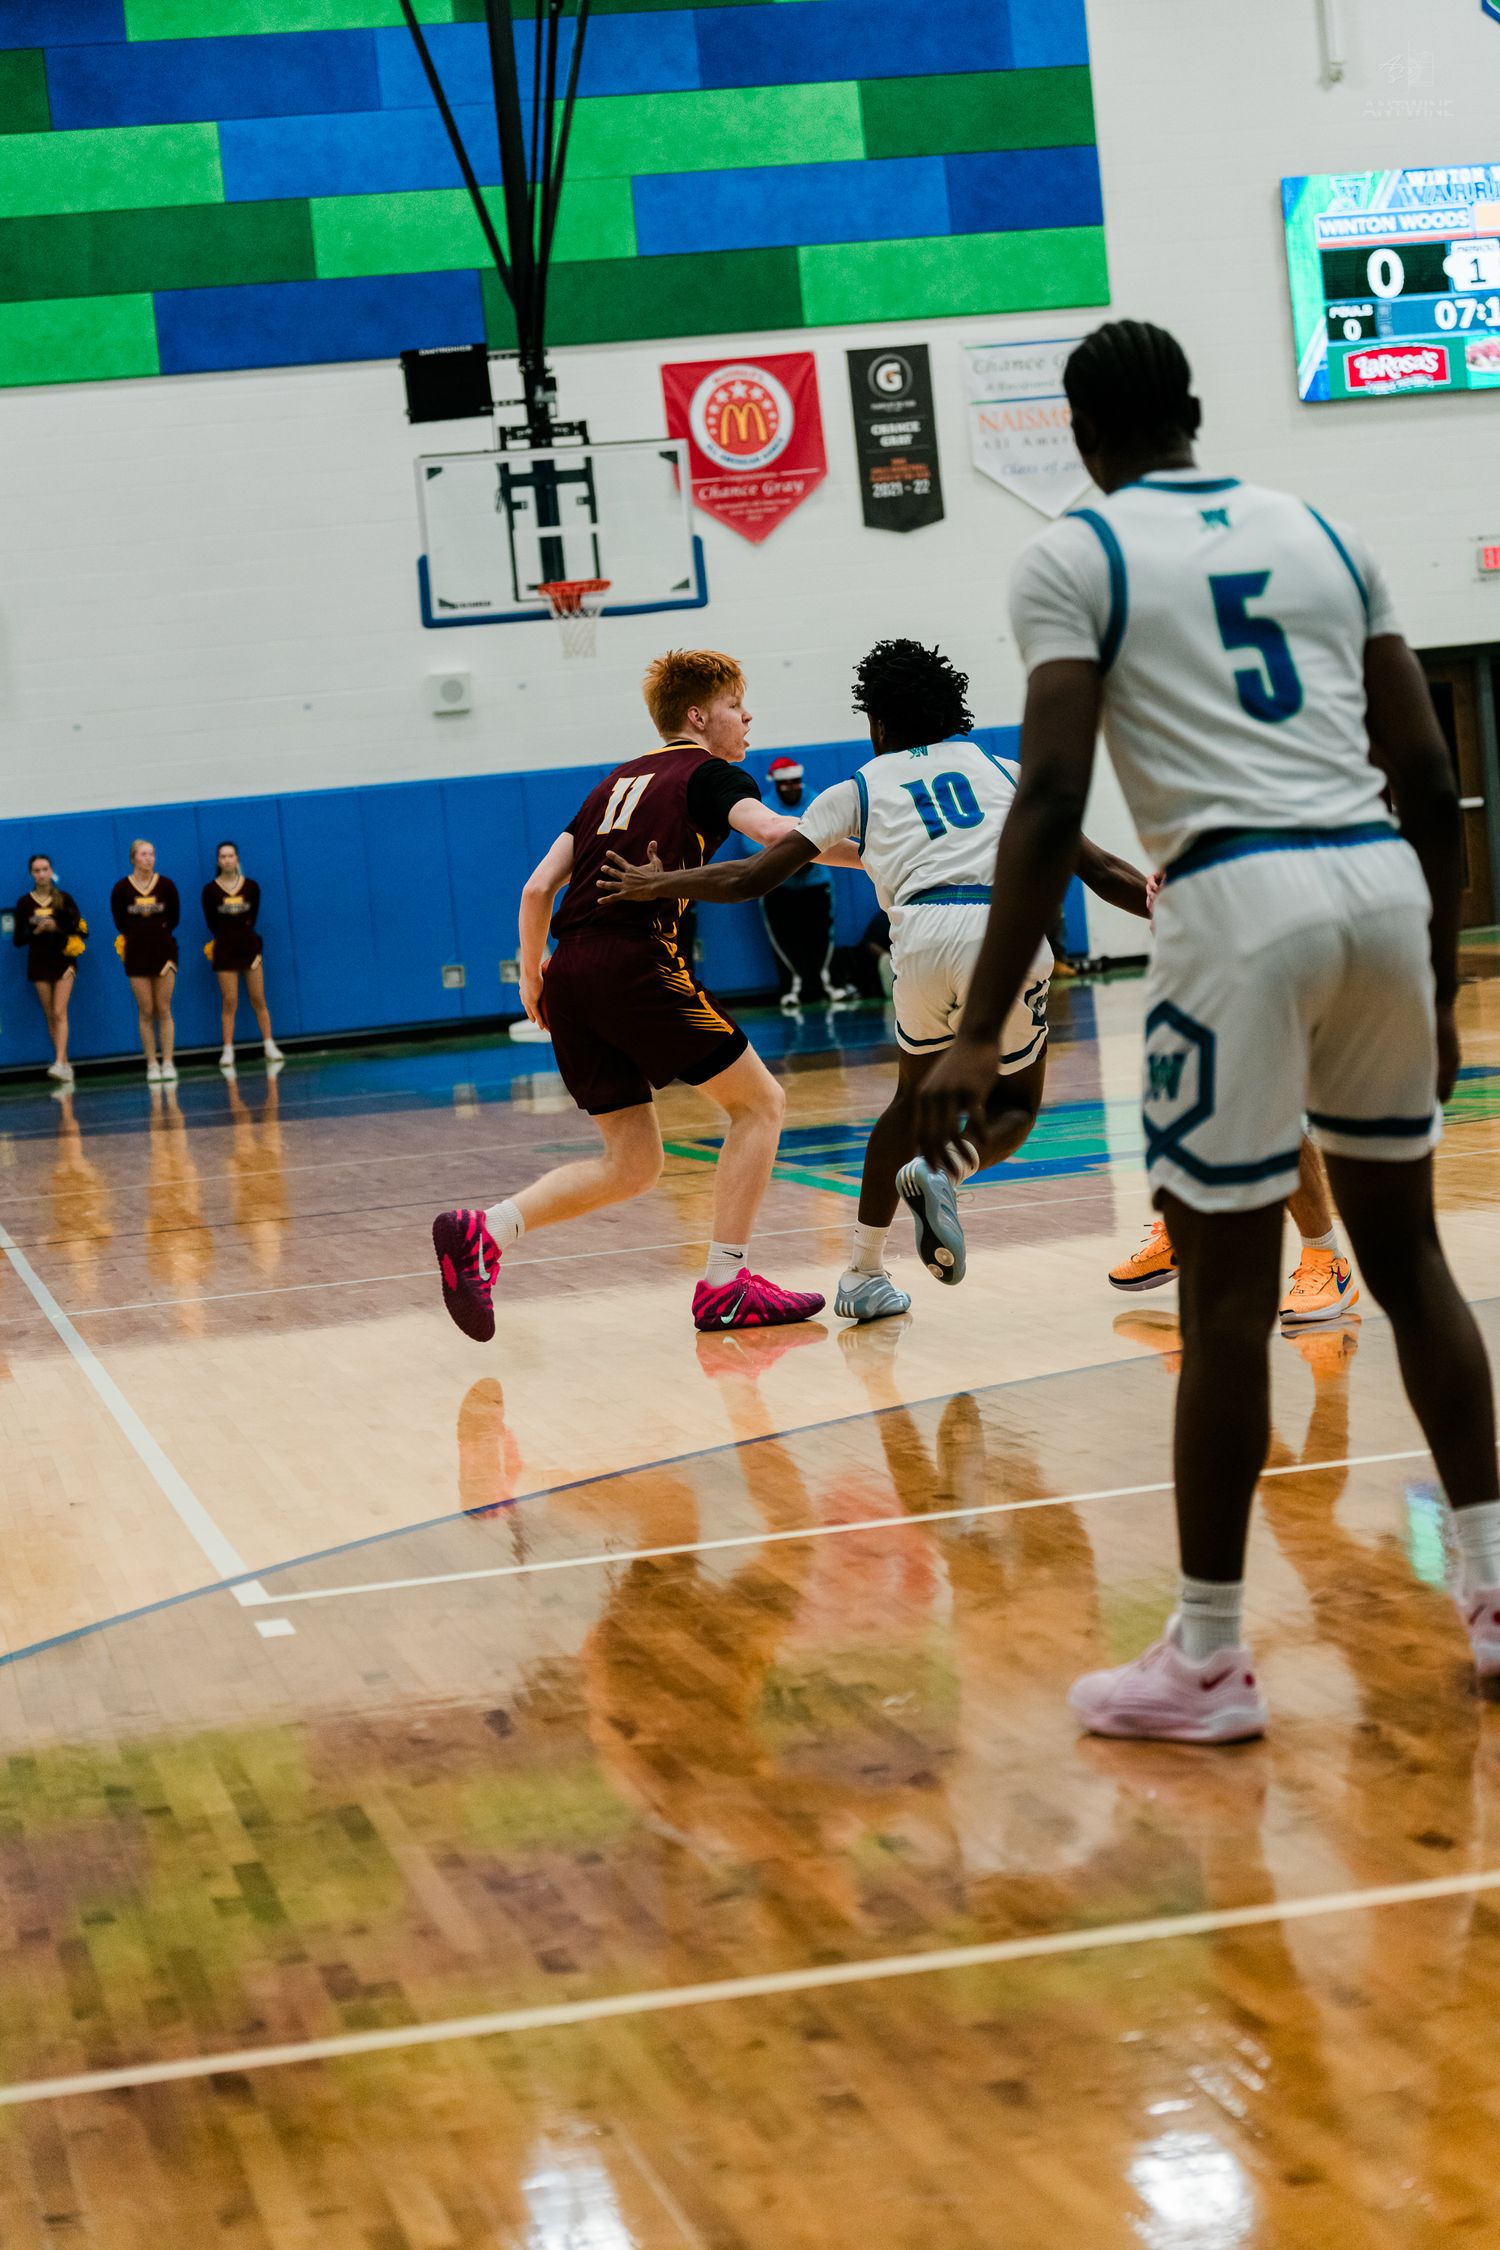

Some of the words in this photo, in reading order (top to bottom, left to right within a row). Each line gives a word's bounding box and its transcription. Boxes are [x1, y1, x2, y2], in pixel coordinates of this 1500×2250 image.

[1319, 215, 1397, 236] WINTON
[1399, 209, 1469, 231] WOODS
[1367, 248, 1404, 298] 0
[1470, 258, 1486, 283] 1
[1343, 318, 1362, 341] 0
[698, 484, 759, 501] Chance
[762, 479, 805, 497] Gray
[1208, 570, 1303, 724] 5
[597, 773, 656, 835] 11
[900, 771, 985, 840] 10
